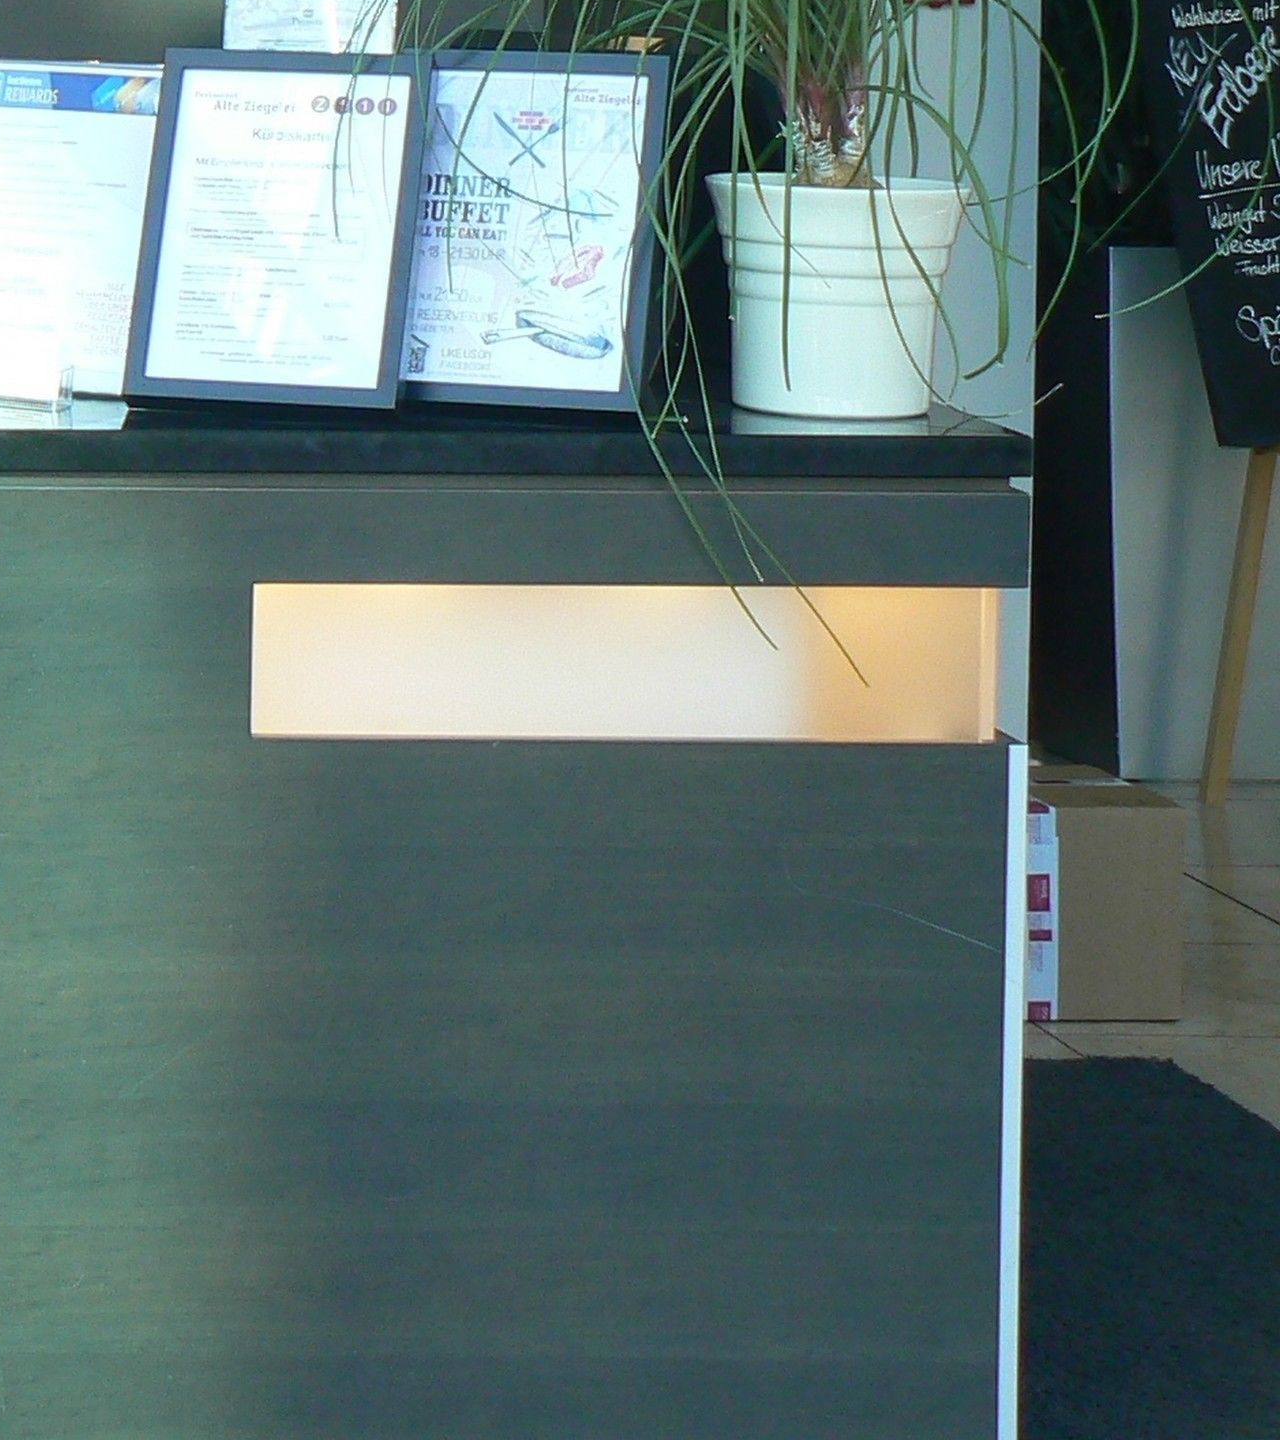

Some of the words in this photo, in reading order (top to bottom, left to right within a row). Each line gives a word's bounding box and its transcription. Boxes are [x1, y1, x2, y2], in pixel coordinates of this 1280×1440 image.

[3, 86, 60, 104] REWARDS
[573, 93, 596, 105] Alte
[213, 99, 240, 112] Alte
[1195, 148, 1268, 191] Unsere
[458, 227, 481, 240] CAN
